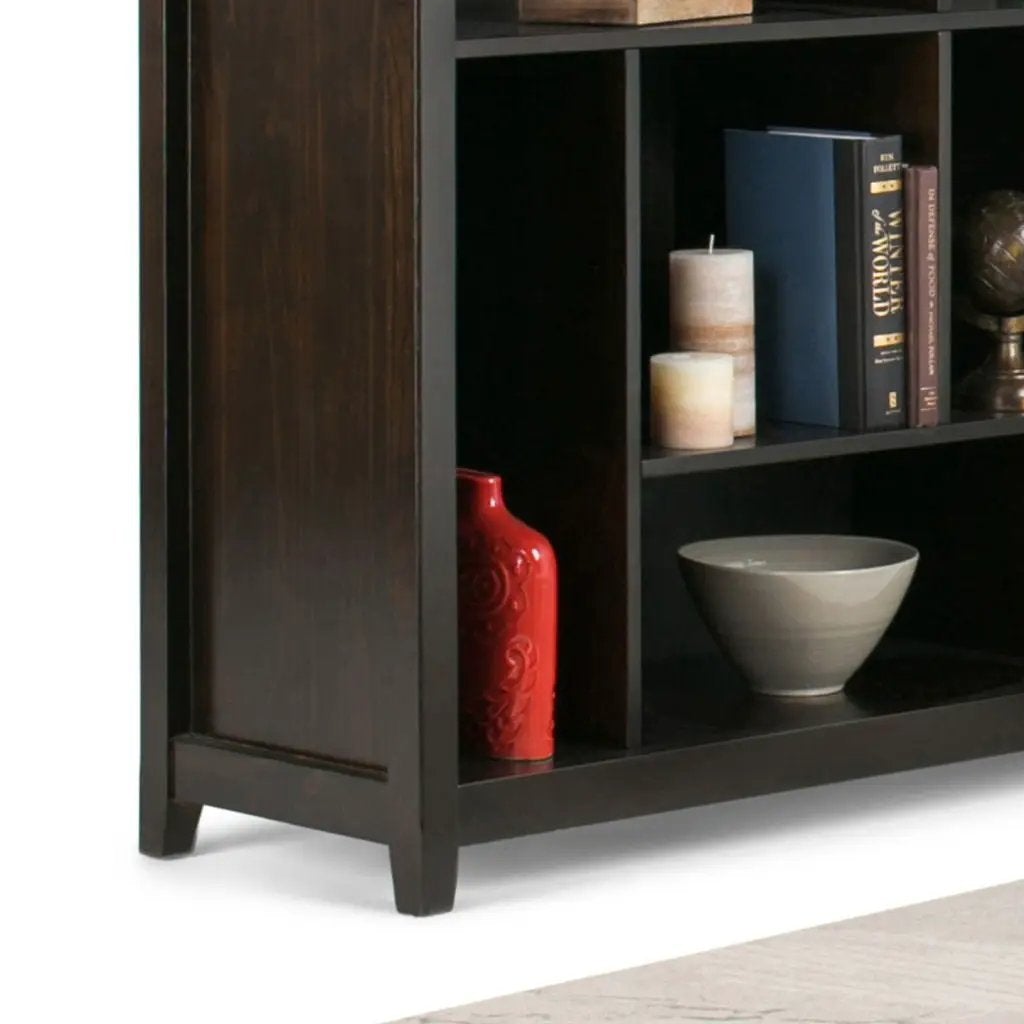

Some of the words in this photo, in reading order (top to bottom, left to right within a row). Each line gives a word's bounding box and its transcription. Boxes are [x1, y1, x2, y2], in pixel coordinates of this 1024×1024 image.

[928, 188, 936, 201] IN
[871, 208, 887, 227] of
[928, 204, 936, 250] DEFENSE
[871, 236, 890, 317] WORLD
[888, 210, 904, 314] WINTER
[928, 265, 937, 298] FOOD
